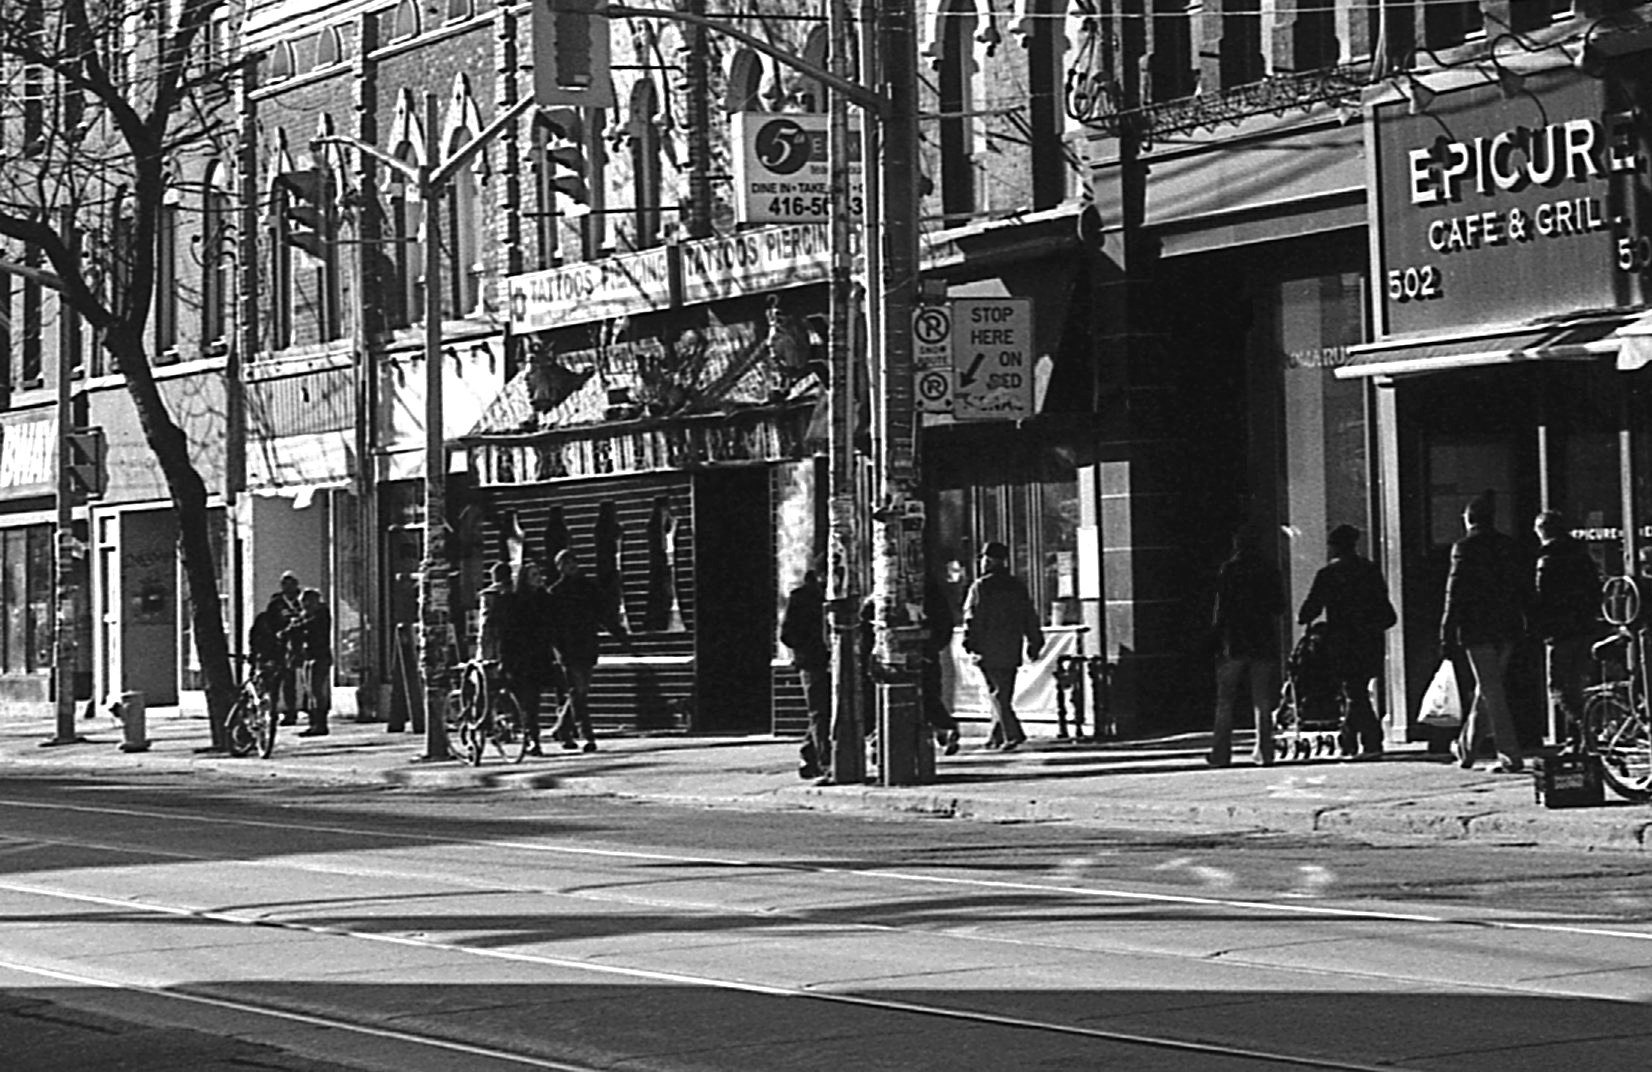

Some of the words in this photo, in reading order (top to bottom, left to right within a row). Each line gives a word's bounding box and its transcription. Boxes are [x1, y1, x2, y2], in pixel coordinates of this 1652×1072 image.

[1428, 211, 1501, 251] CAFE
[1508, 207, 1526, 241] &
[1535, 197, 1623, 236] GRIL
[766, 222, 831, 263] PIERCIN
[530, 269, 594, 304] TATTOOS
[1388, 265, 1435, 300] 502
[971, 307, 1014, 323] STOP
[971, 329, 1015, 345] HERE
[1000, 350, 1022, 367] ON
